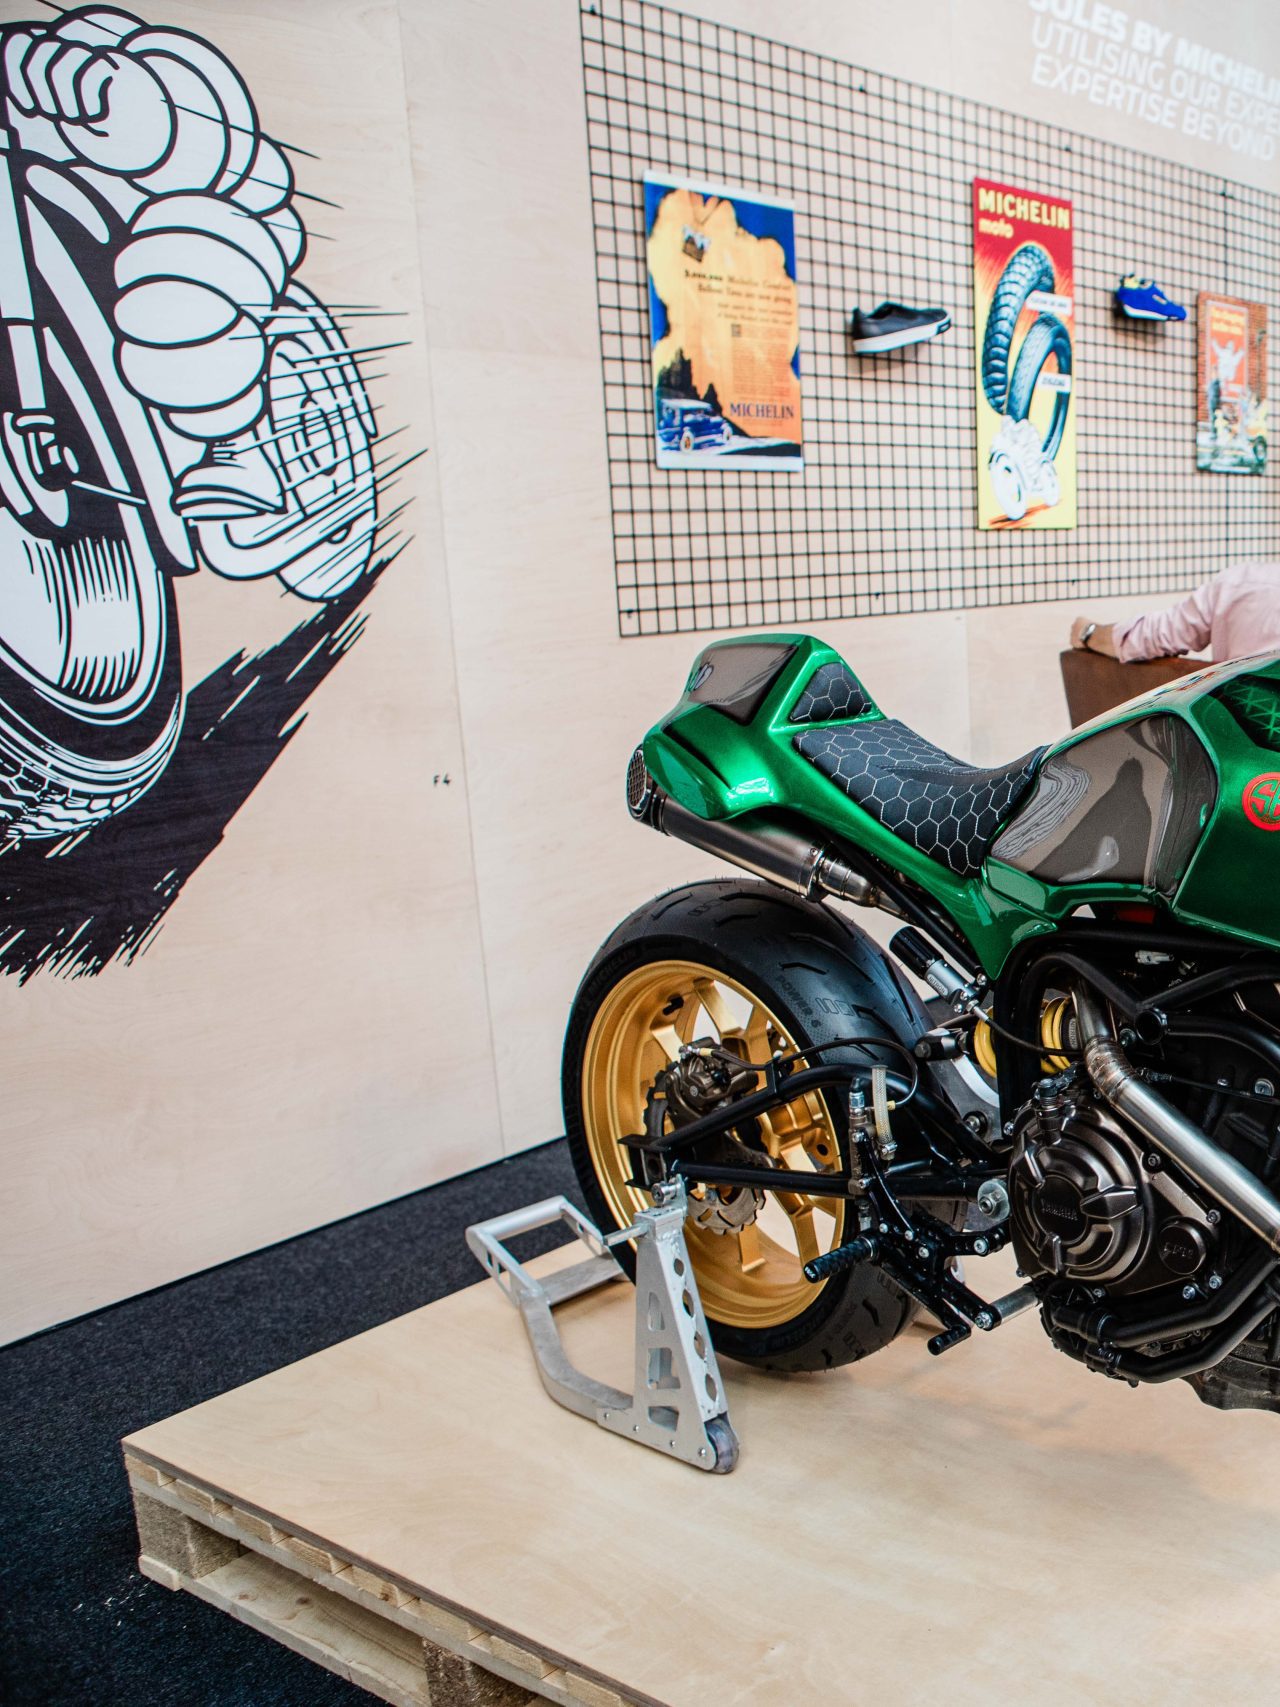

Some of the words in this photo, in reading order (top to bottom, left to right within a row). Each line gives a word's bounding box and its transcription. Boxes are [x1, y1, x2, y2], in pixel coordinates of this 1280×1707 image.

[1131, 20, 1173, 58] BY
[1031, 15, 1168, 92] UTILISING
[1170, 69, 1222, 112] OUR
[1031, 52, 1181, 130] EXPERTISE
[1182, 105, 1277, 162] BEYOND
[978, 186, 1071, 231] MICHELIN
[978, 216, 1014, 240] moto
[729, 402, 795, 421] MICHELIN
